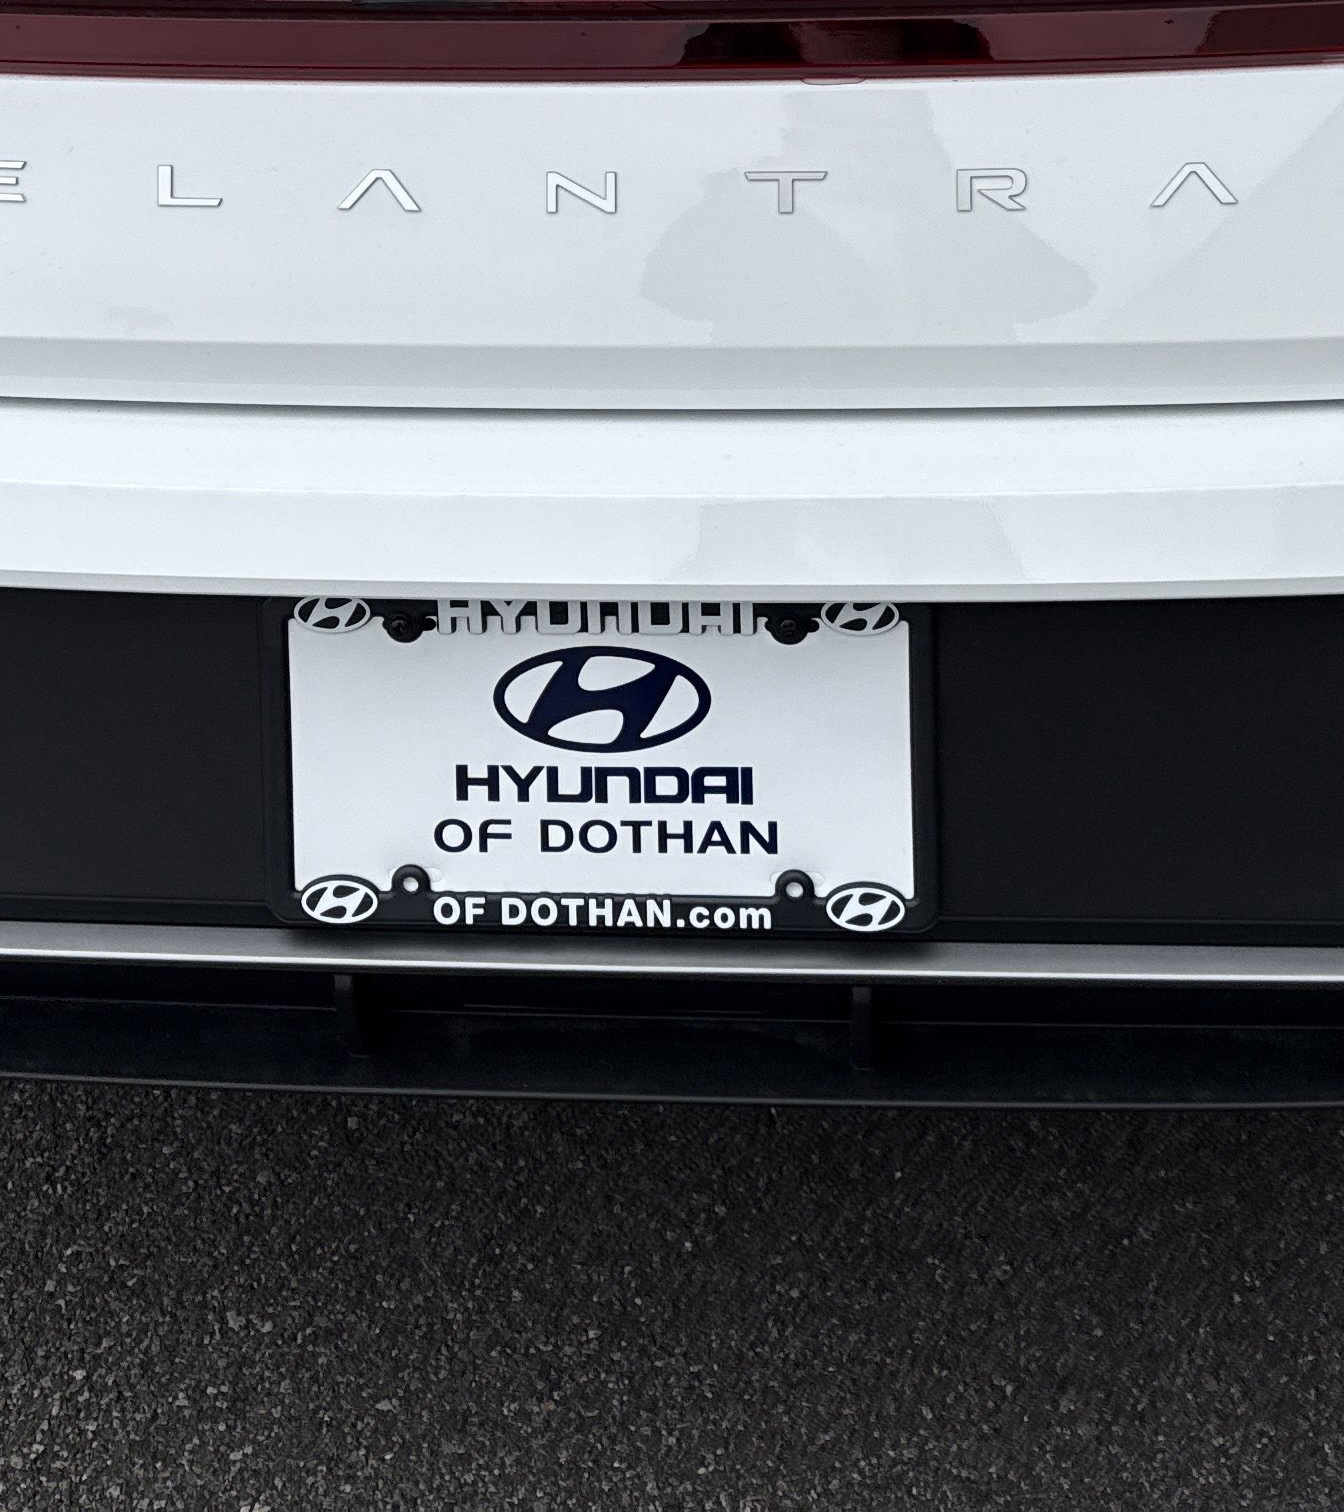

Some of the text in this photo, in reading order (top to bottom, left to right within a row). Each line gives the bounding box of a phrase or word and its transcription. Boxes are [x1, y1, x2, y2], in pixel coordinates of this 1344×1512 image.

[437, 599, 755, 636] HYUNDAI
[455, 764, 754, 805] HYUNDAI
[433, 818, 779, 855] OF DOTHAN
[432, 896, 773, 930] OF DOTHAN.com
